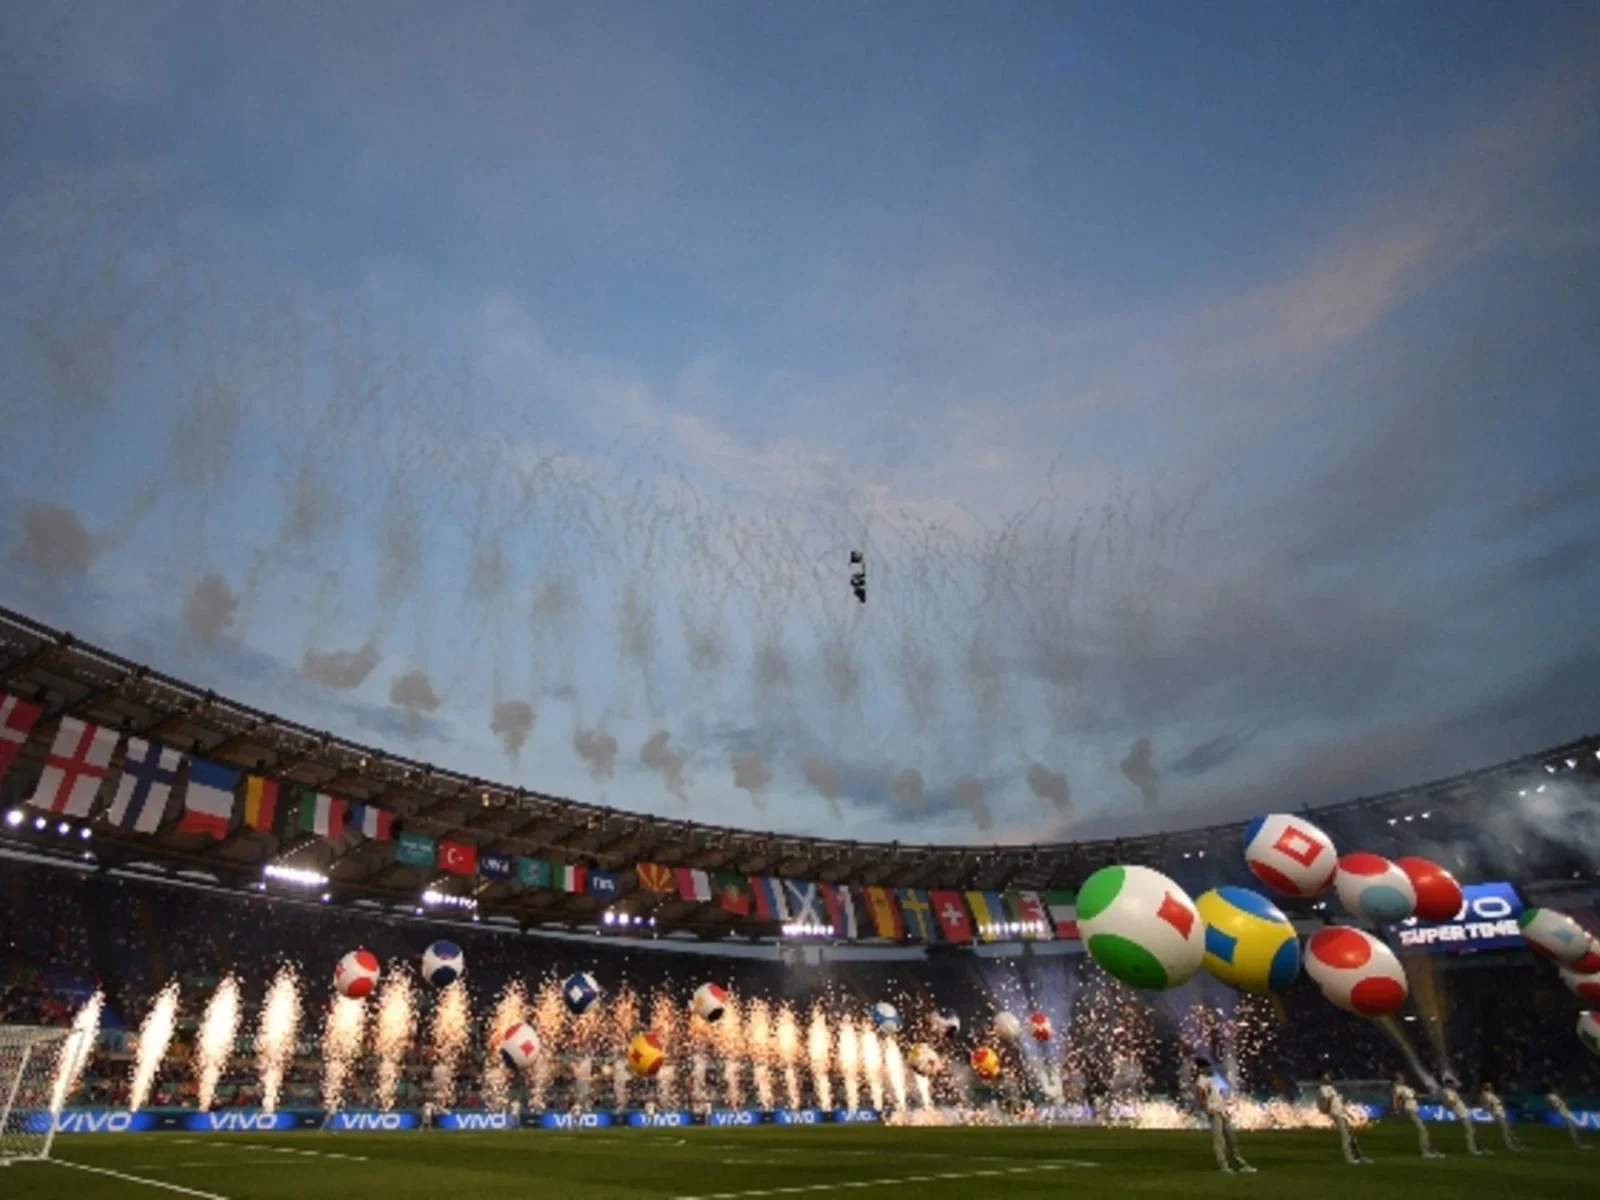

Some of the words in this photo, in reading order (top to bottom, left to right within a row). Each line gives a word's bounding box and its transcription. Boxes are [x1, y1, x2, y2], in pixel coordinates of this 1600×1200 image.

[209, 1112, 278, 1129] VIVO
[342, 1113, 400, 1129] VIVO
[456, 1113, 506, 1129] VIVO
